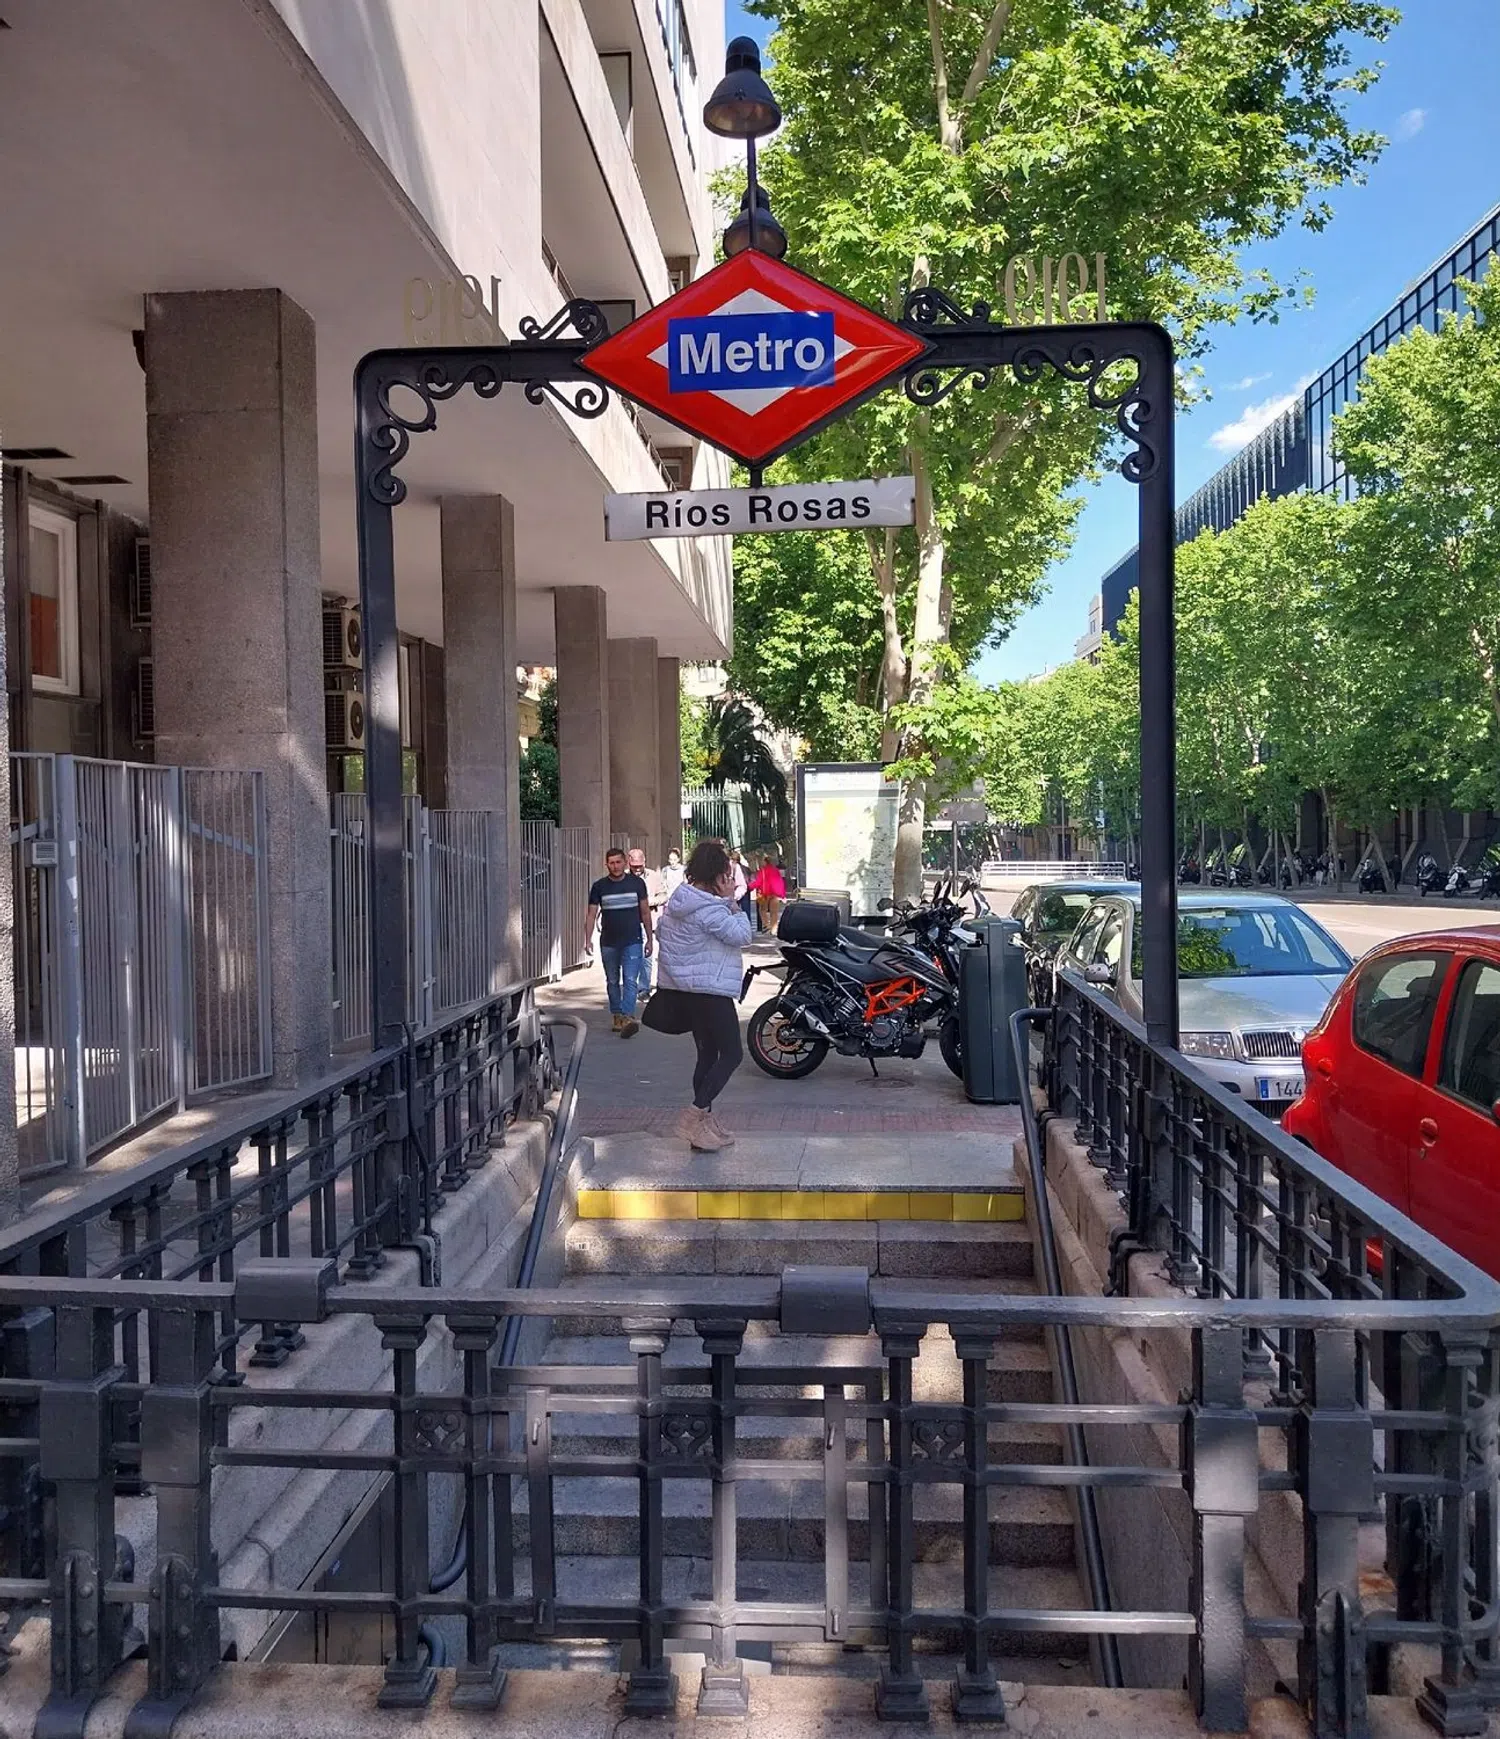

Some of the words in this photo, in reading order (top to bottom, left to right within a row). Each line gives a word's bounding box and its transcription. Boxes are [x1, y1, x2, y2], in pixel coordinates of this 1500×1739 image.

[679, 332, 826, 375] Metro
[645, 499, 731, 529] Ríos
[748, 495, 871, 524] Rosas
